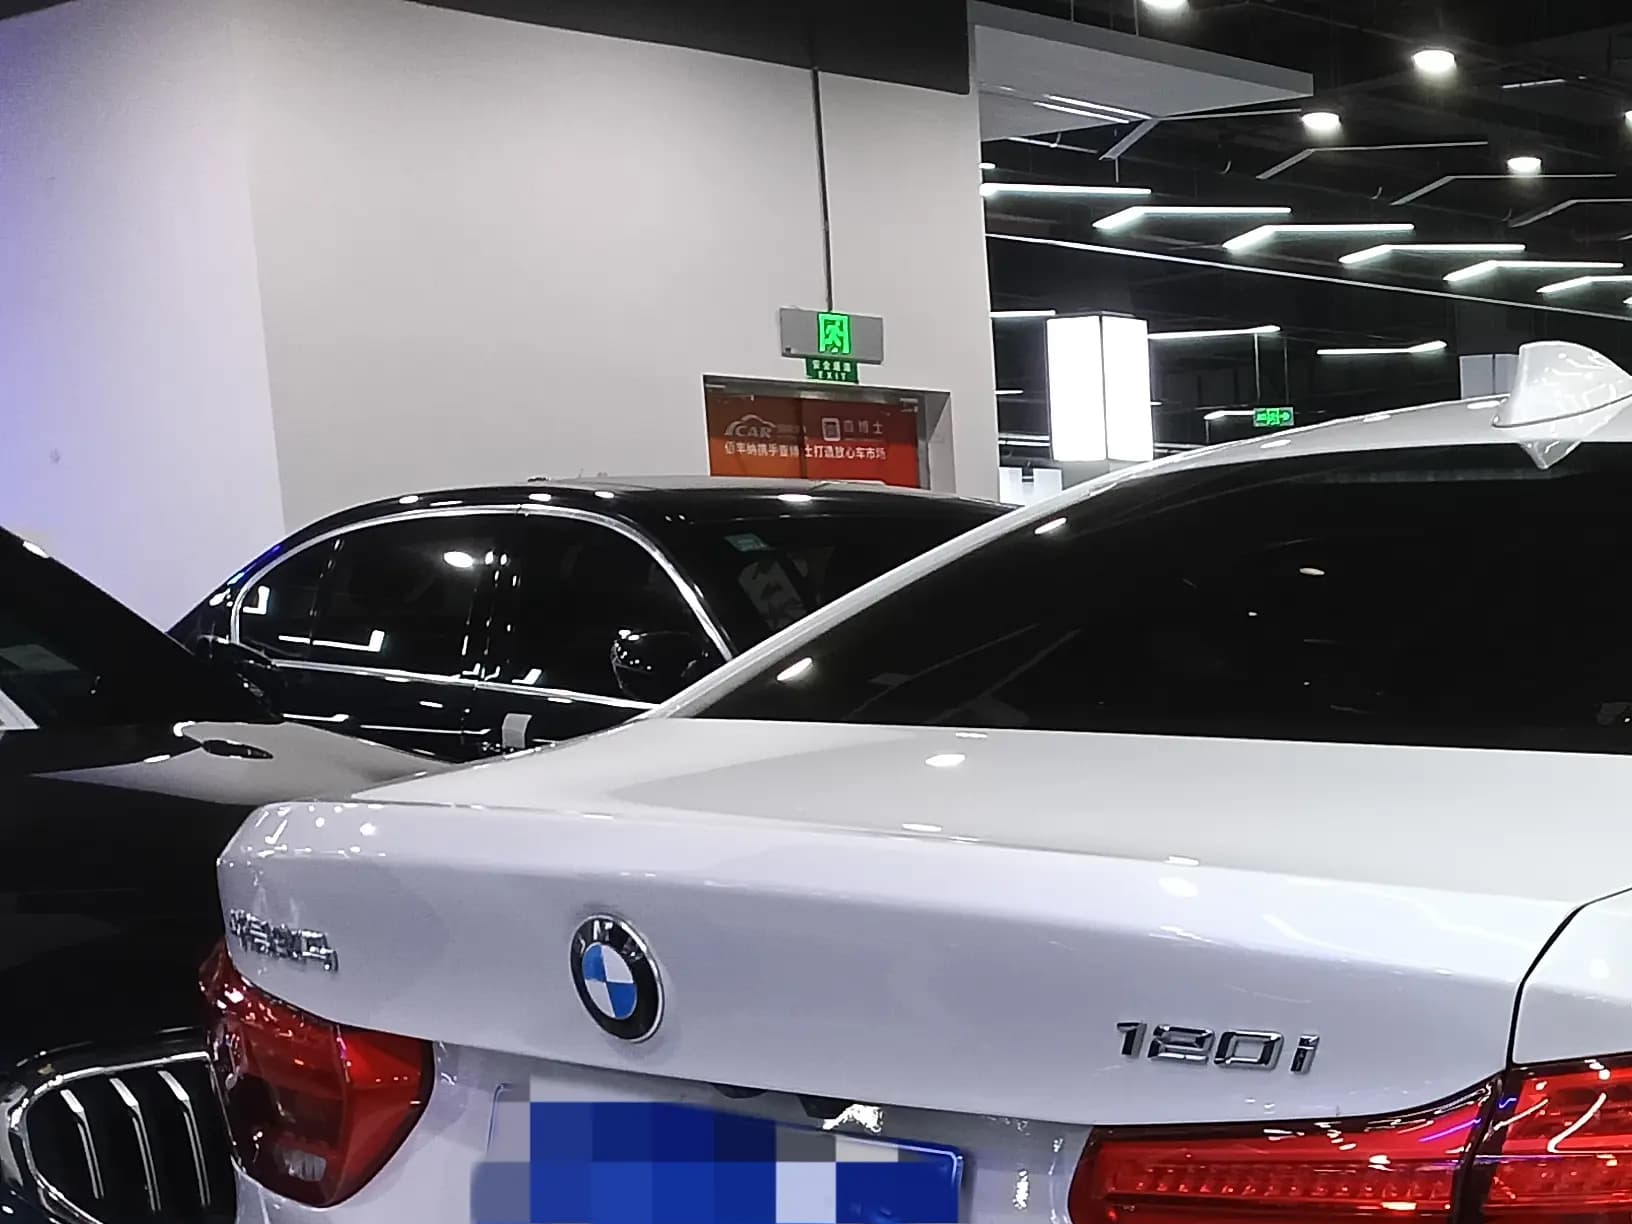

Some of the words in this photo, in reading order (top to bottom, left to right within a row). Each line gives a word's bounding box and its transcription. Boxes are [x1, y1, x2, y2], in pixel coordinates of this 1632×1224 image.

[817, 370, 846, 380] EXIT
[735, 425, 772, 439] CAR
[1115, 1020, 1322, 1076] 120i
